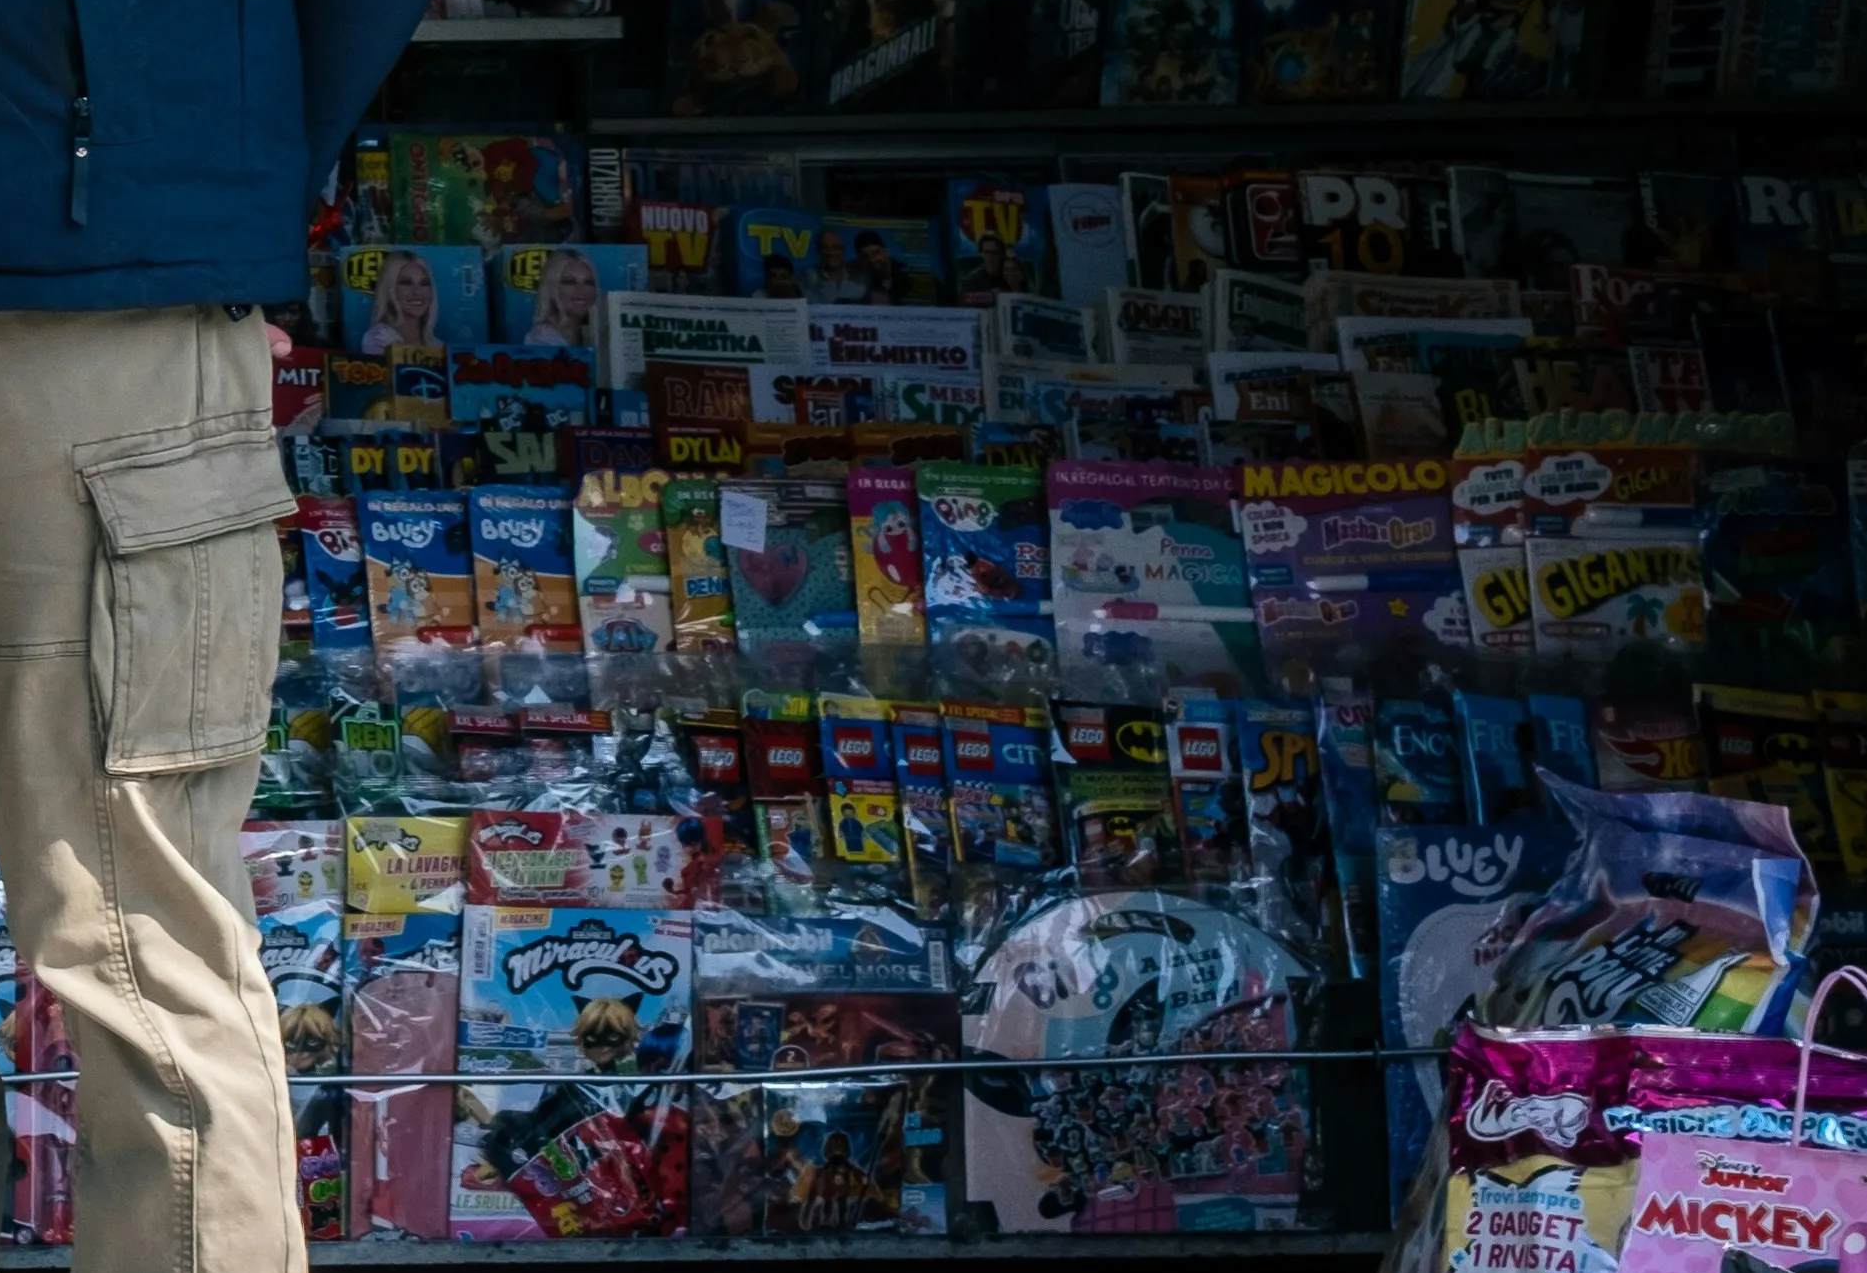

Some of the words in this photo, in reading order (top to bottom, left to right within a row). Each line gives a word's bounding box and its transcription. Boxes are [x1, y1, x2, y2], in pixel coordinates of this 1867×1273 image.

[641, 206, 710, 233] NUOVO
[649, 232, 713, 270] TV
[747, 225, 813, 258] TV
[838, 738, 871, 757] LEGO
[955, 741, 990, 759] LEGO
[1069, 729, 1105, 747] LEGO
[769, 749, 803, 767] LEGO
[1703, 1169, 1790, 1194] Junior
[1467, 1211, 1481, 1234] 2
[1488, 1214, 1583, 1243] GADGET
[1638, 1192, 1843, 1252] MICKEY
[1473, 1243, 1483, 1268] 1
